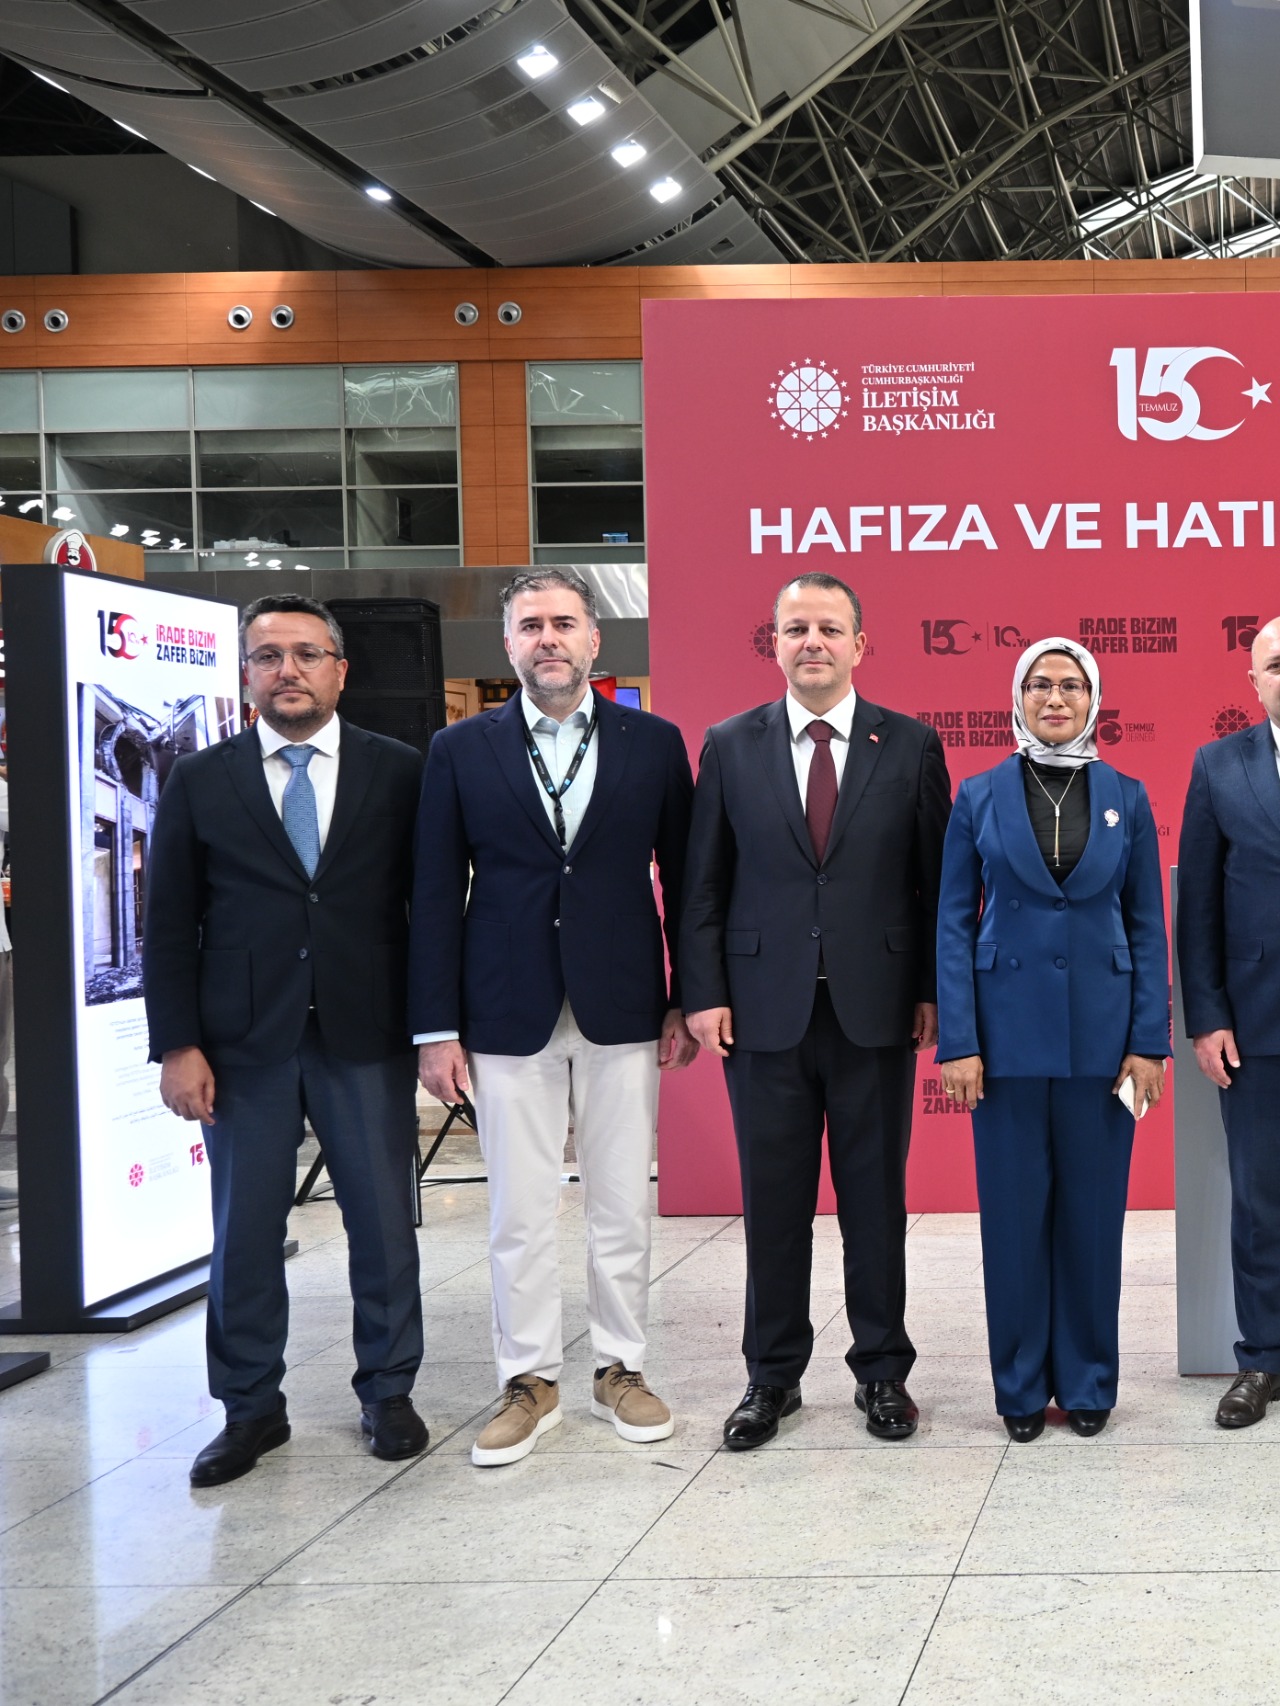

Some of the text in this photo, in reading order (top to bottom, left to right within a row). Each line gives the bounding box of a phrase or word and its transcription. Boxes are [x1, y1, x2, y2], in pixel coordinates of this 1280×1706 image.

[862, 361, 975, 375] TÜRKİYE CUMHURİYETİ
[862, 374, 963, 386] CUMHURBAŞKANLIĞI
[862, 387, 959, 411] İLETİŞİM
[1139, 403, 1178, 412] TEMMUZ
[862, 409, 996, 435] BAŞKANLIĞI
[750, 505, 998, 554] HAFIZA
[1013, 503, 1102, 550] VE
[1079, 617, 1177, 635] İRADE BİZİM
[156, 624, 216, 649] İRADE BİZİM
[1079, 637, 1177, 653] ZAFER BİZİM
[156, 644, 216, 667] ZAFER BİZİM
[1125, 723, 1155, 732] TEMMUZ
[969, 730, 1013, 747] BİZİM
